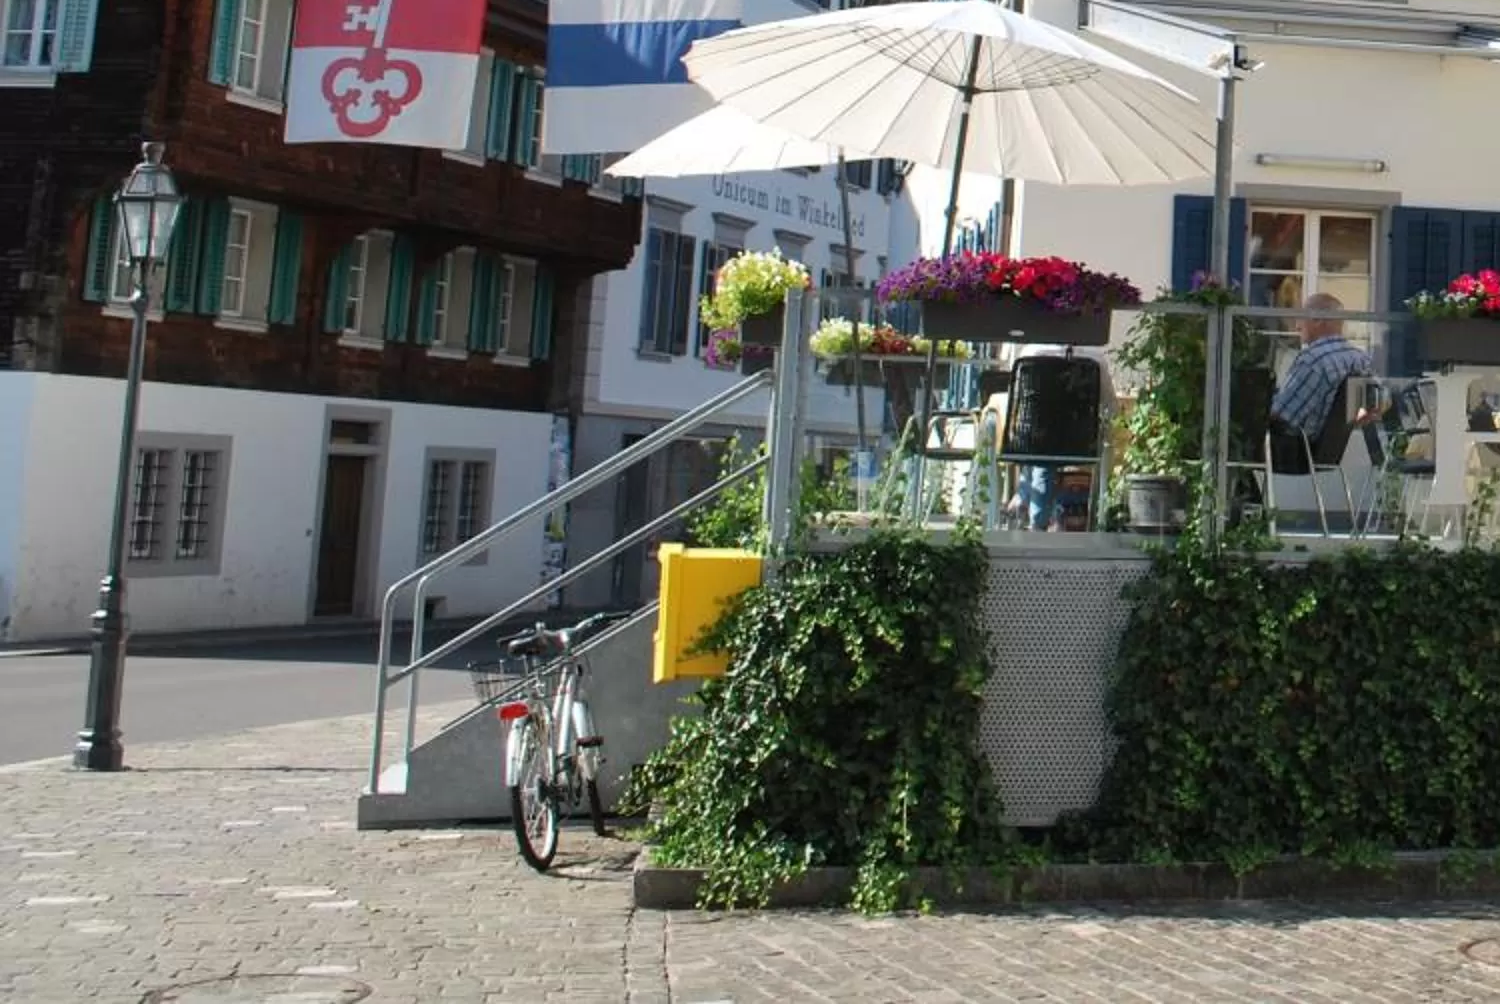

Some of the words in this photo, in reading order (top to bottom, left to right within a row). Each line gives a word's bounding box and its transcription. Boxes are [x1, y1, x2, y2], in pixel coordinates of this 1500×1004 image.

[712, 171, 769, 210] Unicum
[775, 187, 792, 216] im
[798, 195, 866, 237] Winkeled
